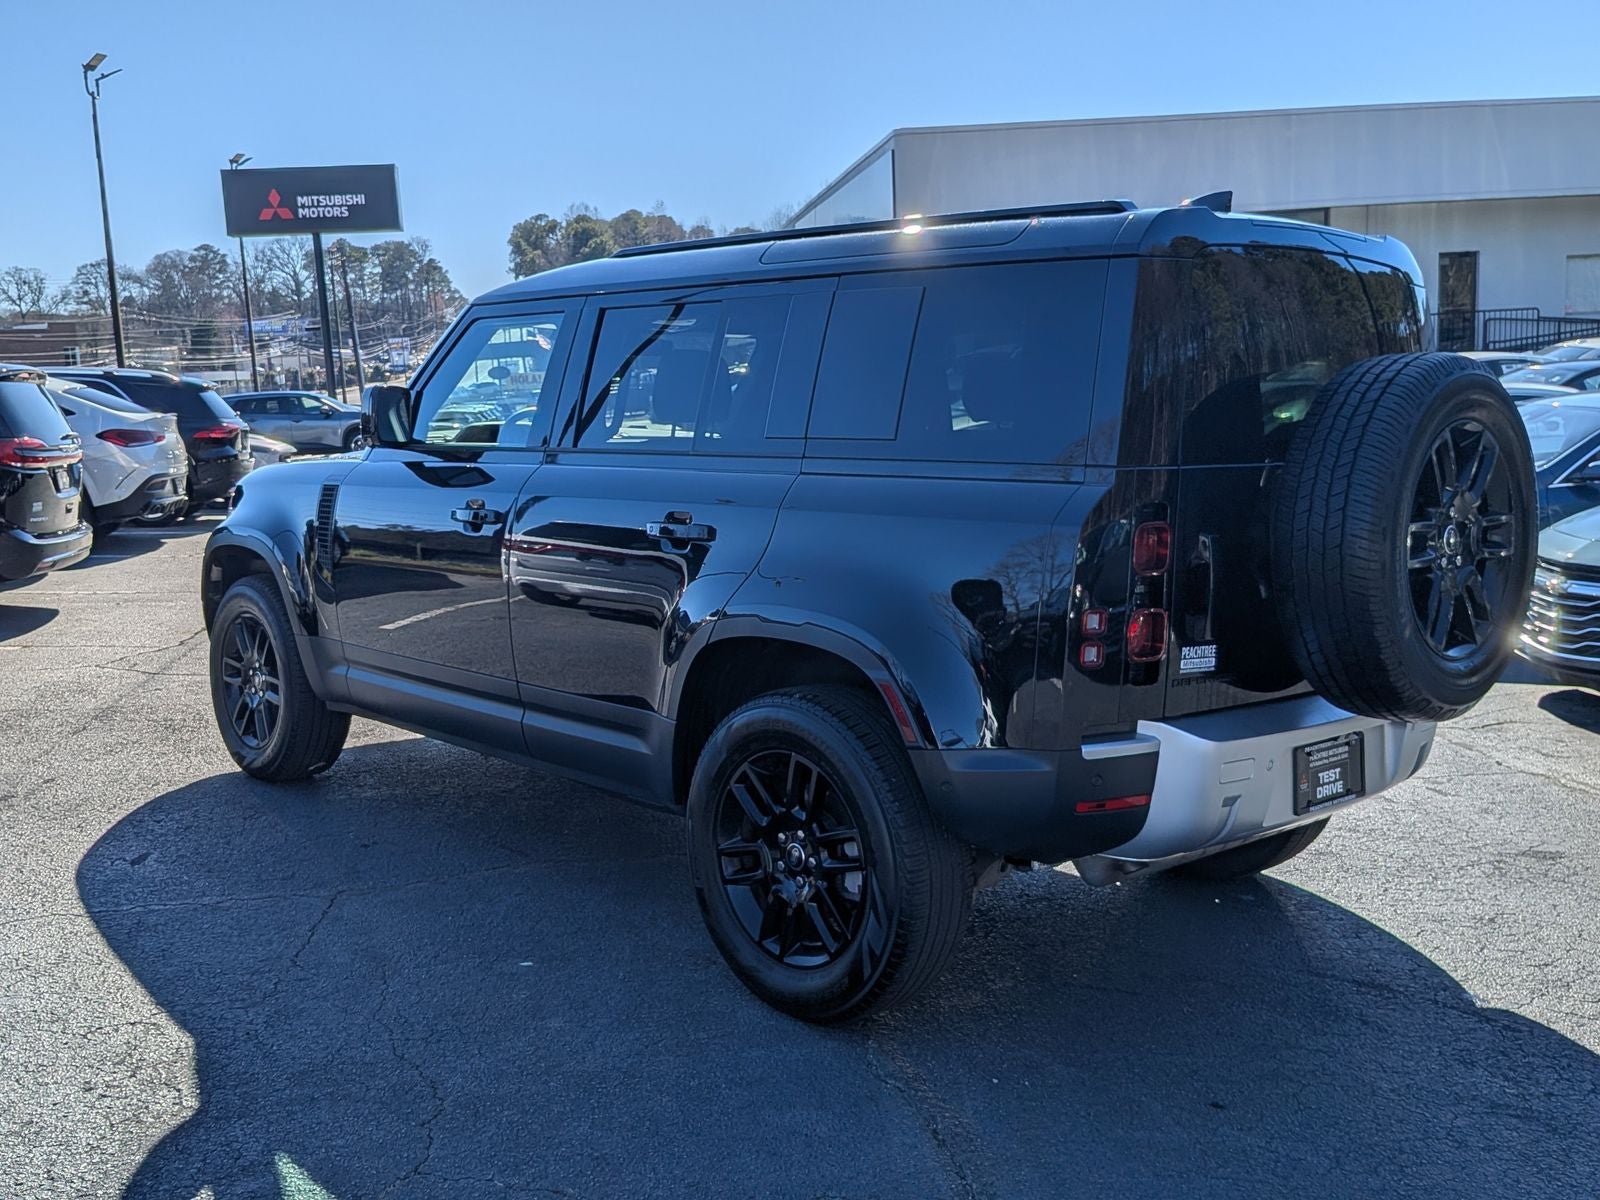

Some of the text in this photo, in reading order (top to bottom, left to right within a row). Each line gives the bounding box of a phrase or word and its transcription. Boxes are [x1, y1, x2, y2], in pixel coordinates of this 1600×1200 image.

[297, 194, 366, 207] MITSUBISHI
[298, 207, 349, 219] MOTORS
[1181, 645, 1216, 659] PEACHTREE
[1318, 768, 1341, 784] TEST
[1316, 780, 1344, 799] DRIVE
